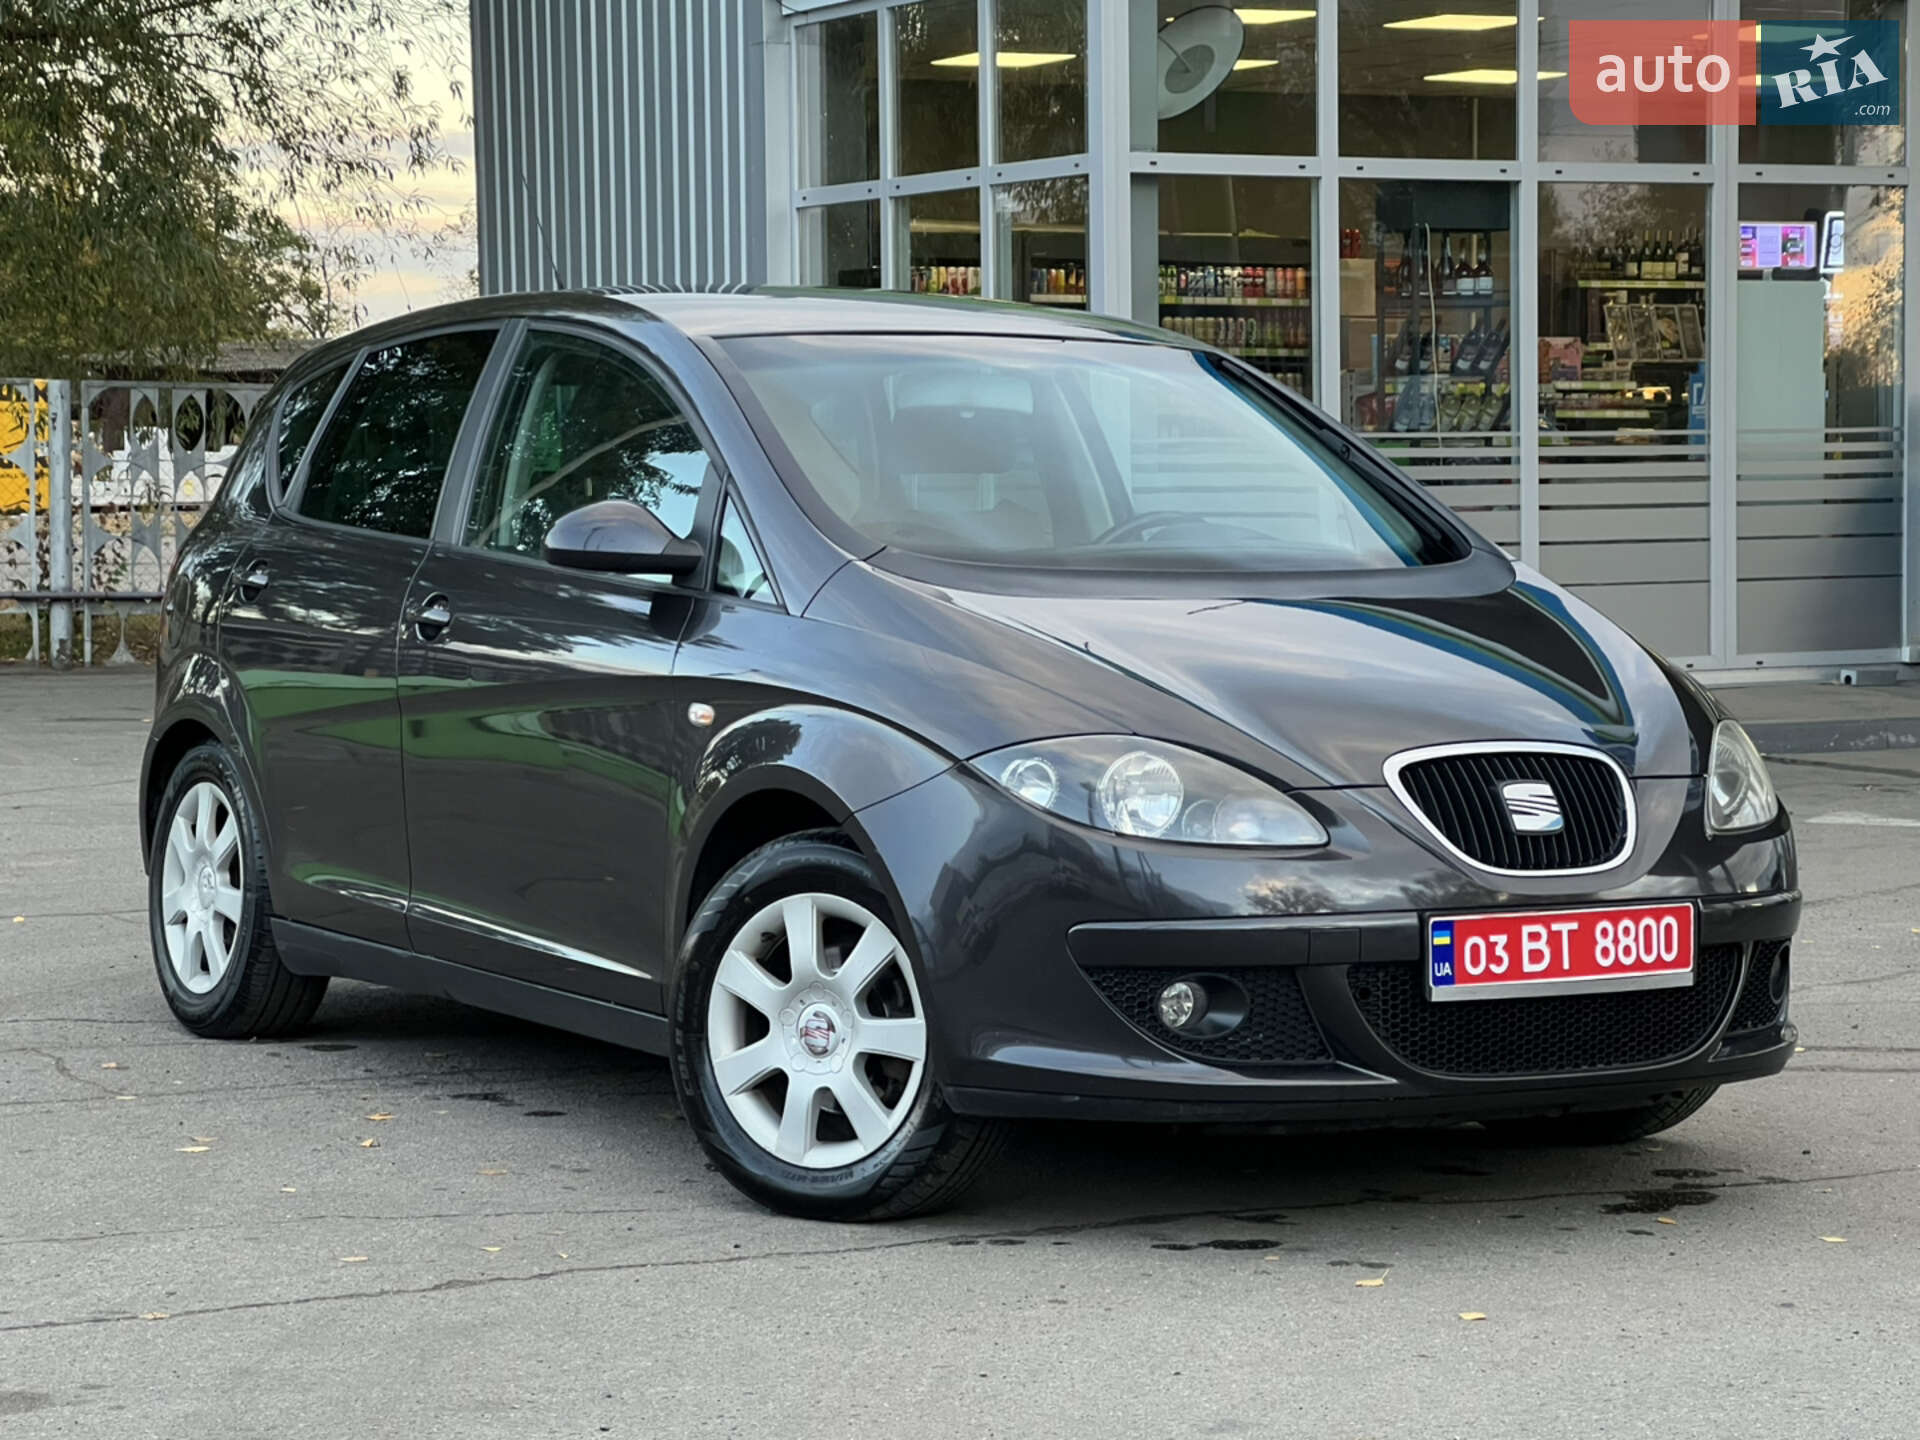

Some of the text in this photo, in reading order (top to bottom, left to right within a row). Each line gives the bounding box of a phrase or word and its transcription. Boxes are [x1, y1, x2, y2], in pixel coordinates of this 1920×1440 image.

[1463, 915, 1679, 976] 03 BT 8800
[1434, 962, 1452, 977] UA
